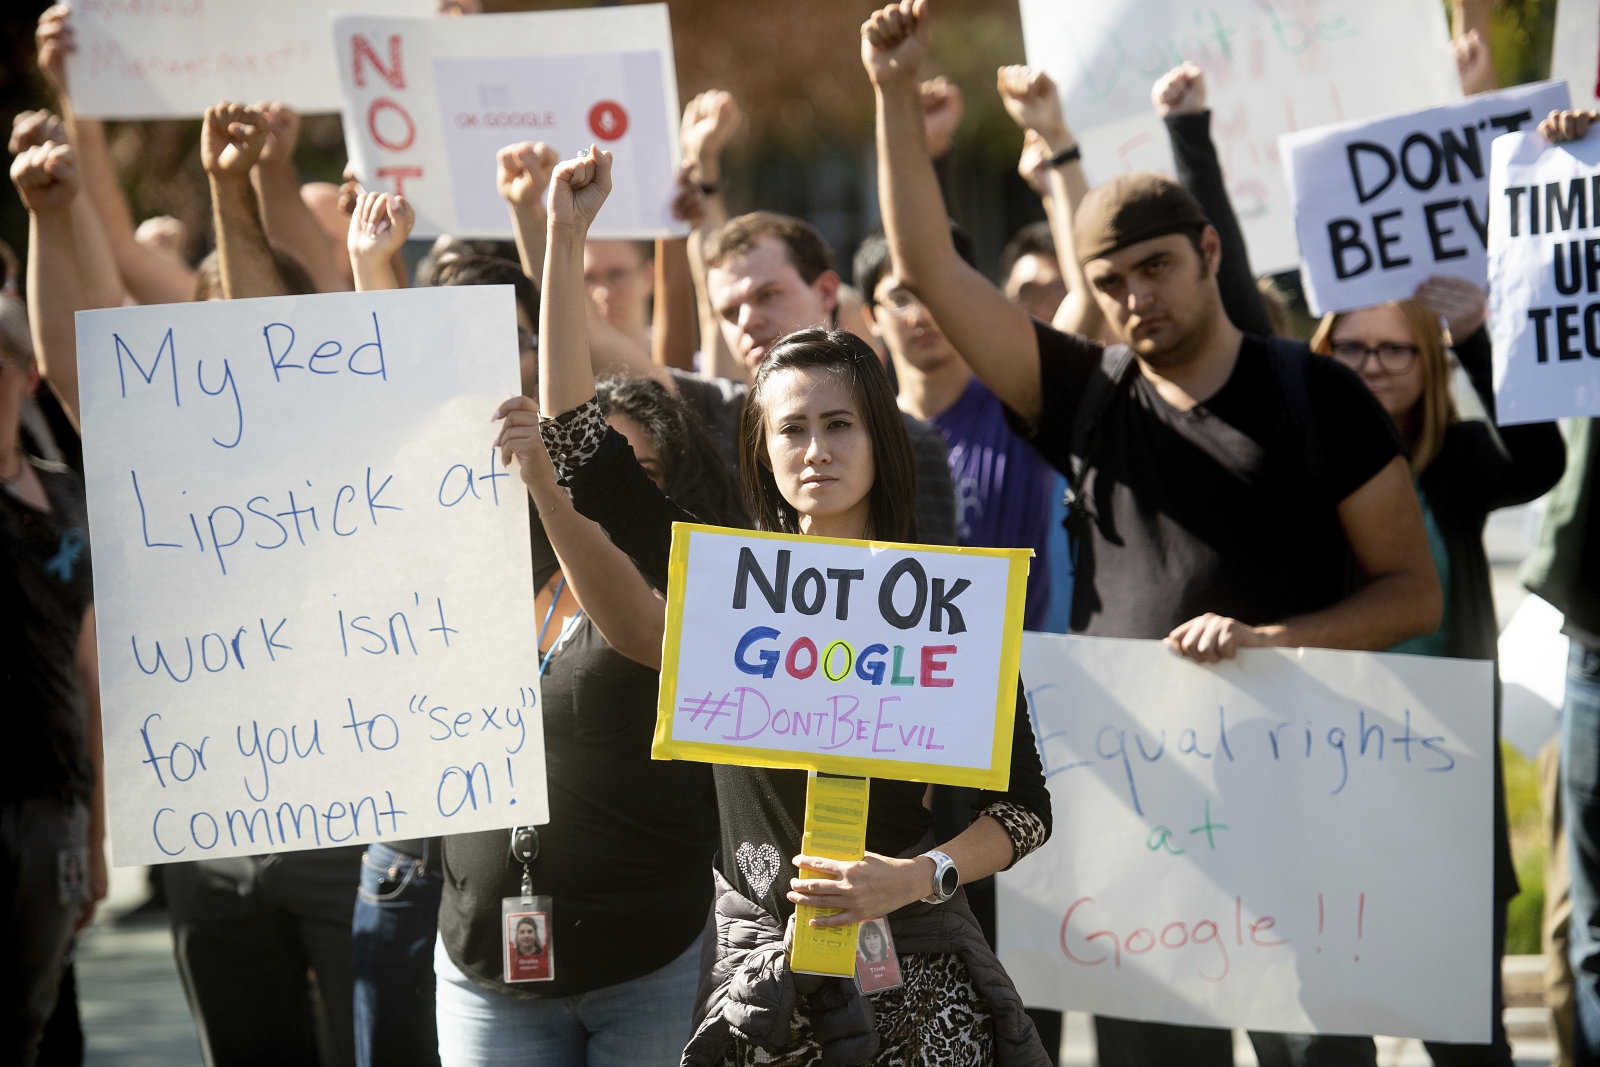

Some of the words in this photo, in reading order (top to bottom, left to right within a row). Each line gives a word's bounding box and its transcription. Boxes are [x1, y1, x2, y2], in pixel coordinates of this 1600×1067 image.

[454, 111, 480, 129] OK
[482, 110, 556, 130] GOOGLE
[1327, 209, 1411, 280] BE
[1505, 174, 1600, 238] TIM
[112, 327, 243, 449] My
[263, 311, 388, 382] Red
[131, 466, 404, 576] Lipstick
[438, 448, 510, 507] at
[731, 546, 865, 621] NOT
[877, 557, 972, 635] OK
[131, 618, 293, 683] work
[332, 592, 460, 656] isn't
[733, 625, 959, 688] GOOGLE
[140, 713, 211, 788] for
[236, 719, 325, 803] you
[342, 697, 400, 753] to
[1026, 682, 1235, 817] Equal
[1268, 708, 1456, 797] rights
[153, 790, 408, 856] comment
[437, 757, 518, 818] on!
[1146, 797, 1230, 855] at
